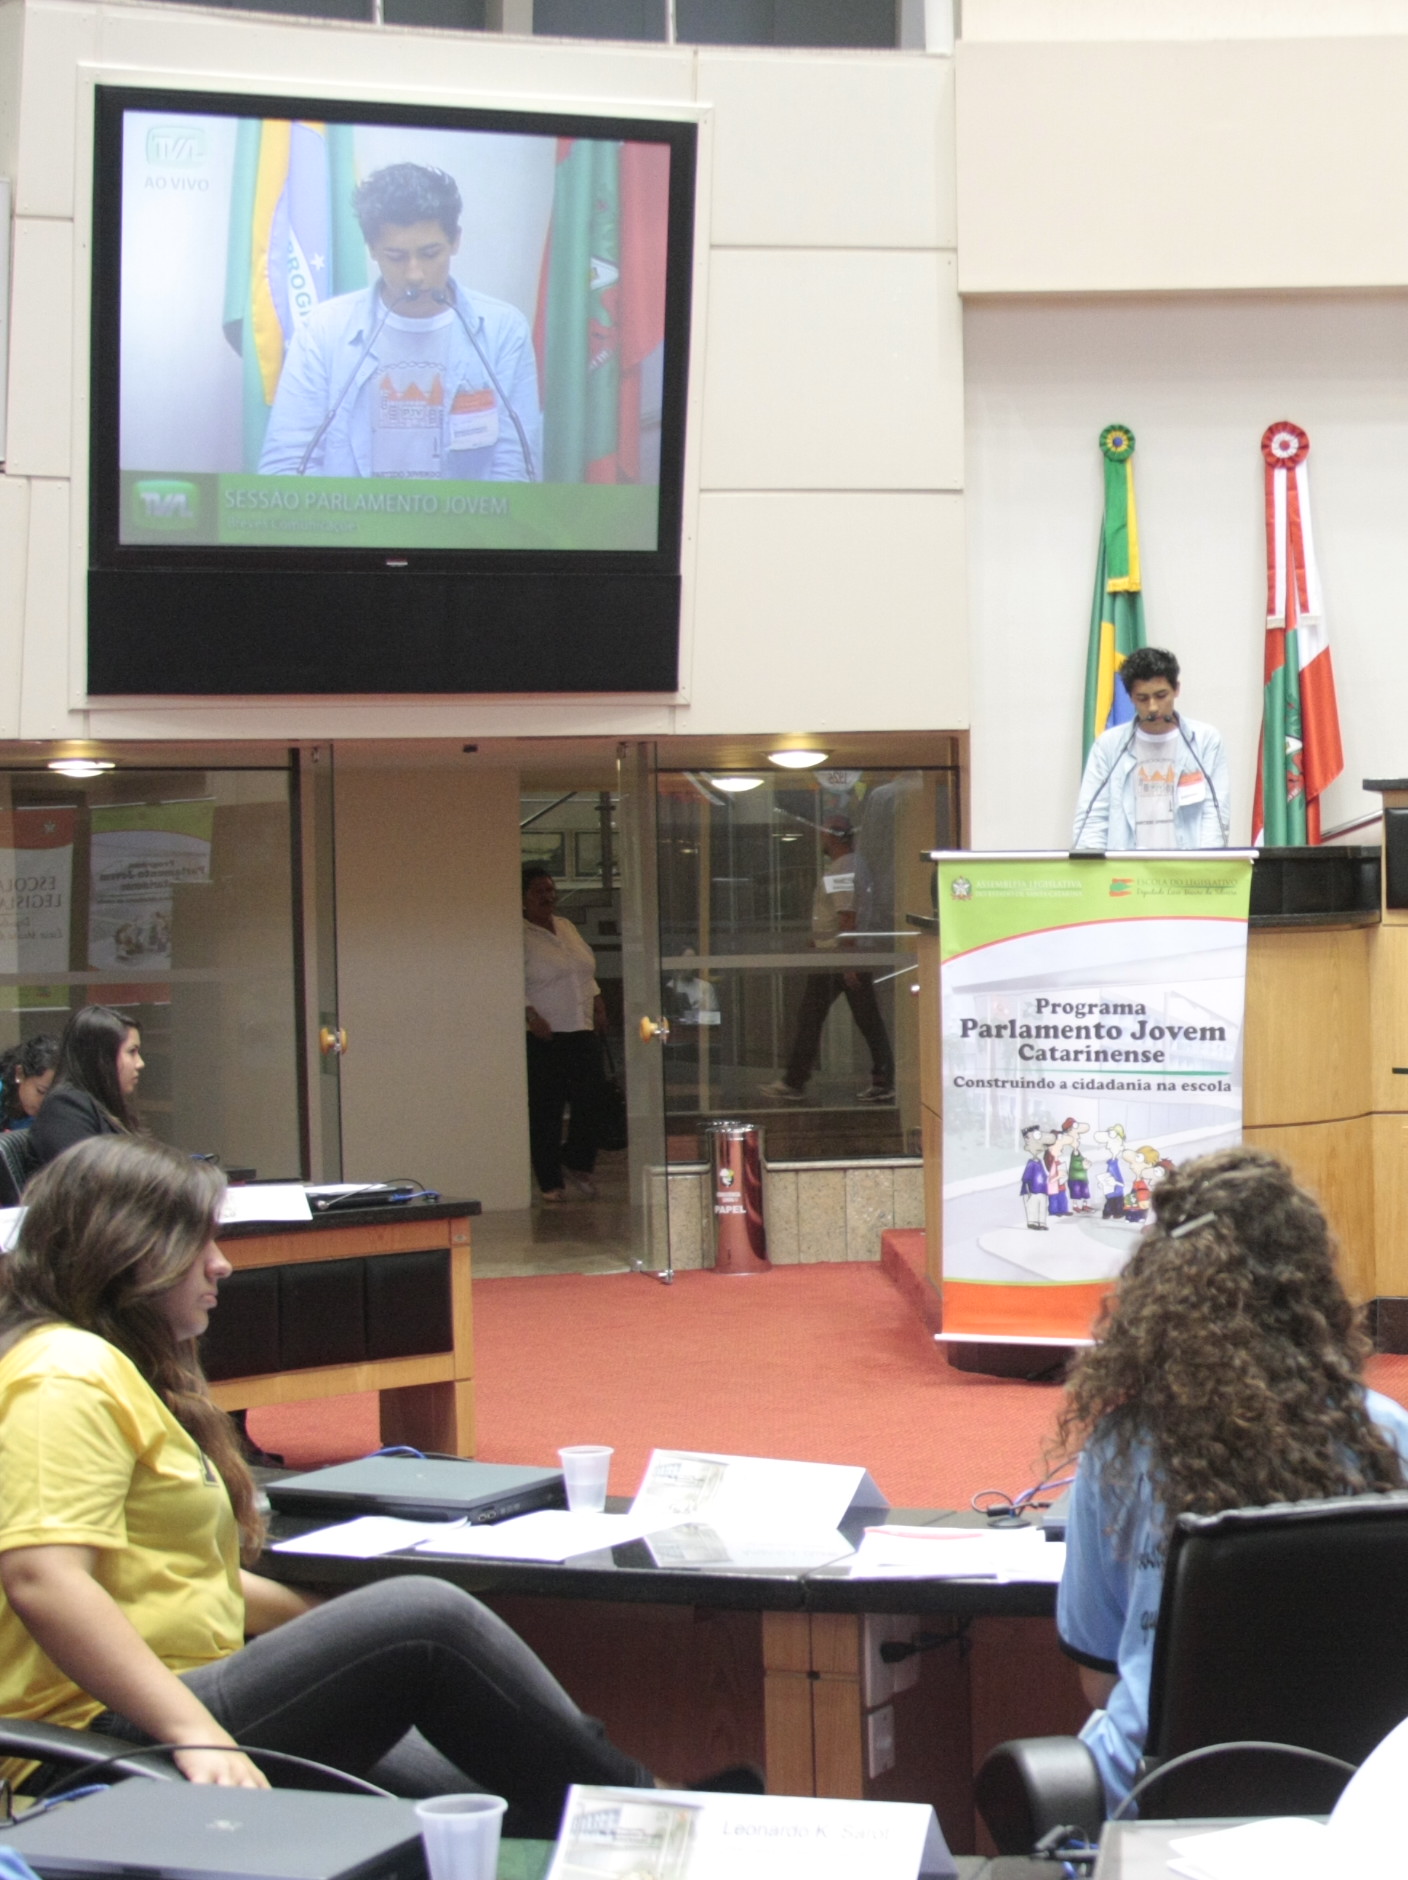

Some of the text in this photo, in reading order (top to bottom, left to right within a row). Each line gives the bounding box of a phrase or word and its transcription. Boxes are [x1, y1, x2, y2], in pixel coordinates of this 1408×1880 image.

[144, 176, 210, 192] AO VIVO
[224, 487, 509, 517] SESSÃO PARLAMENTO JOVEM
[1035, 997, 1147, 1017] Programa
[960, 1019, 1227, 1042] Parlamento Jovem
[1018, 1044, 1166, 1063] Catarinense
[953, 1076, 1232, 1092] Construindo a cidadania na escola
[714, 1205, 747, 1214] PAPEL
